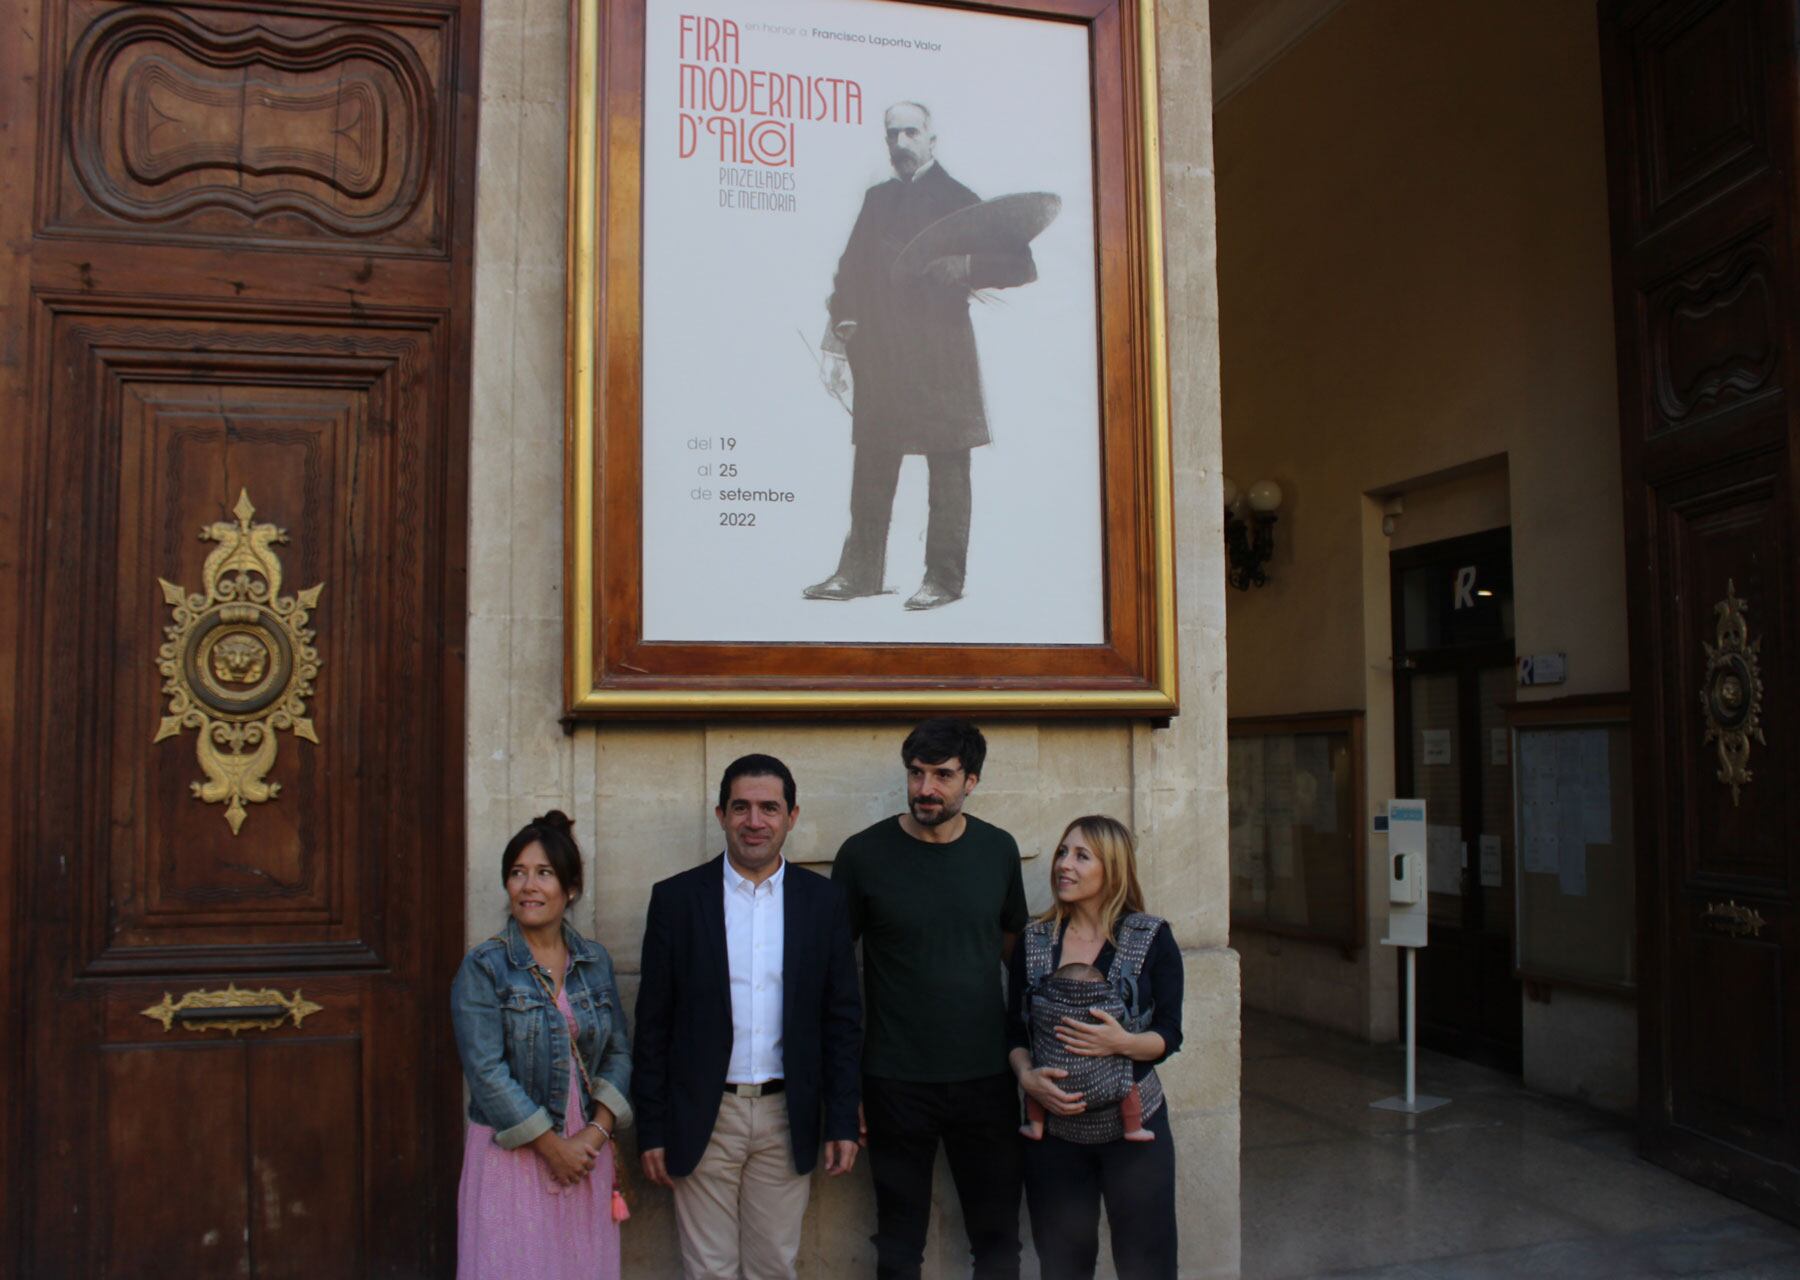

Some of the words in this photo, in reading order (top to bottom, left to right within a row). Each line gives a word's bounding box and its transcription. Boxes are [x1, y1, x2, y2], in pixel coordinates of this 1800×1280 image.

[679, 14, 739, 64] FIRA
[745, 22, 760, 31] en
[763, 24, 797, 35] honor
[800, 28, 808, 36] a
[812, 27, 866, 43] Francisco
[868, 35, 912, 48] Laporta
[914, 40, 942, 51] Valor
[679, 63, 862, 124] MODERNISTA
[719, 167, 796, 191] PINZELLADES
[719, 189, 735, 208] DE
[687, 436, 712, 450] del
[720, 437, 737, 451] 19
[697, 463, 712, 477] al
[719, 463, 738, 477] 25
[690, 486, 712, 501] de
[719, 487, 795, 502] setembre
[719, 512, 757, 527] 2022
[1454, 565, 1477, 610] R
